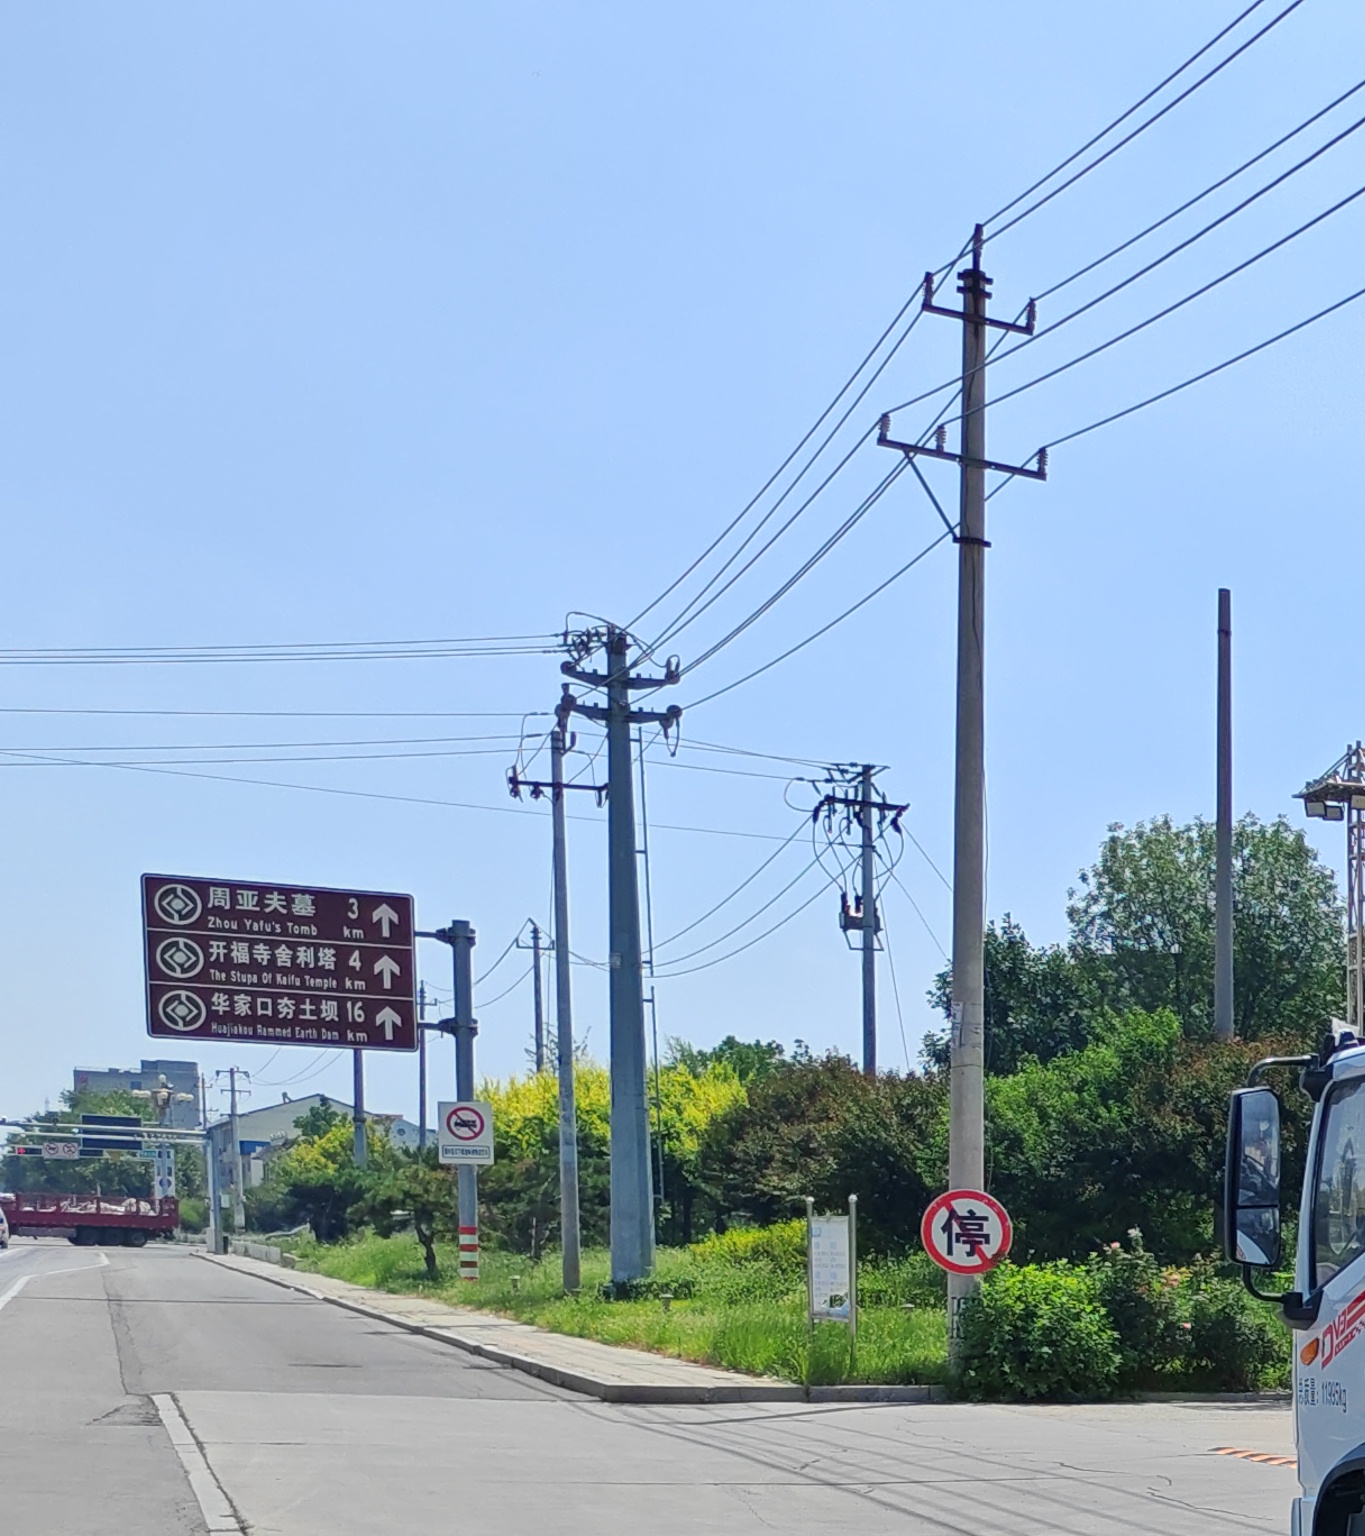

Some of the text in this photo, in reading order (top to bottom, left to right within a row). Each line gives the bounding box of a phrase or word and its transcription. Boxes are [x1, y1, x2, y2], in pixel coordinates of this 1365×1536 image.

[207, 886, 317, 917] 周亚夫墓
[348, 897, 359, 919] 3
[207, 916, 318, 936] Zhou Yafu's Tomb
[343, 926, 364, 939] km
[209, 940, 337, 970] 开福寺舍利塔
[349, 949, 362, 971] 4
[209, 969, 338, 990] The Stupa Of Kaifu Temple
[345, 977, 366, 991] km
[211, 991, 339, 1022] 华家口夯土坝
[347, 1000, 365, 1023] 16
[211, 1021, 340, 1040] Huajiakou Rammed Earth Dam
[347, 1030, 368, 1043] km
[940, 1208, 991, 1258] 停
